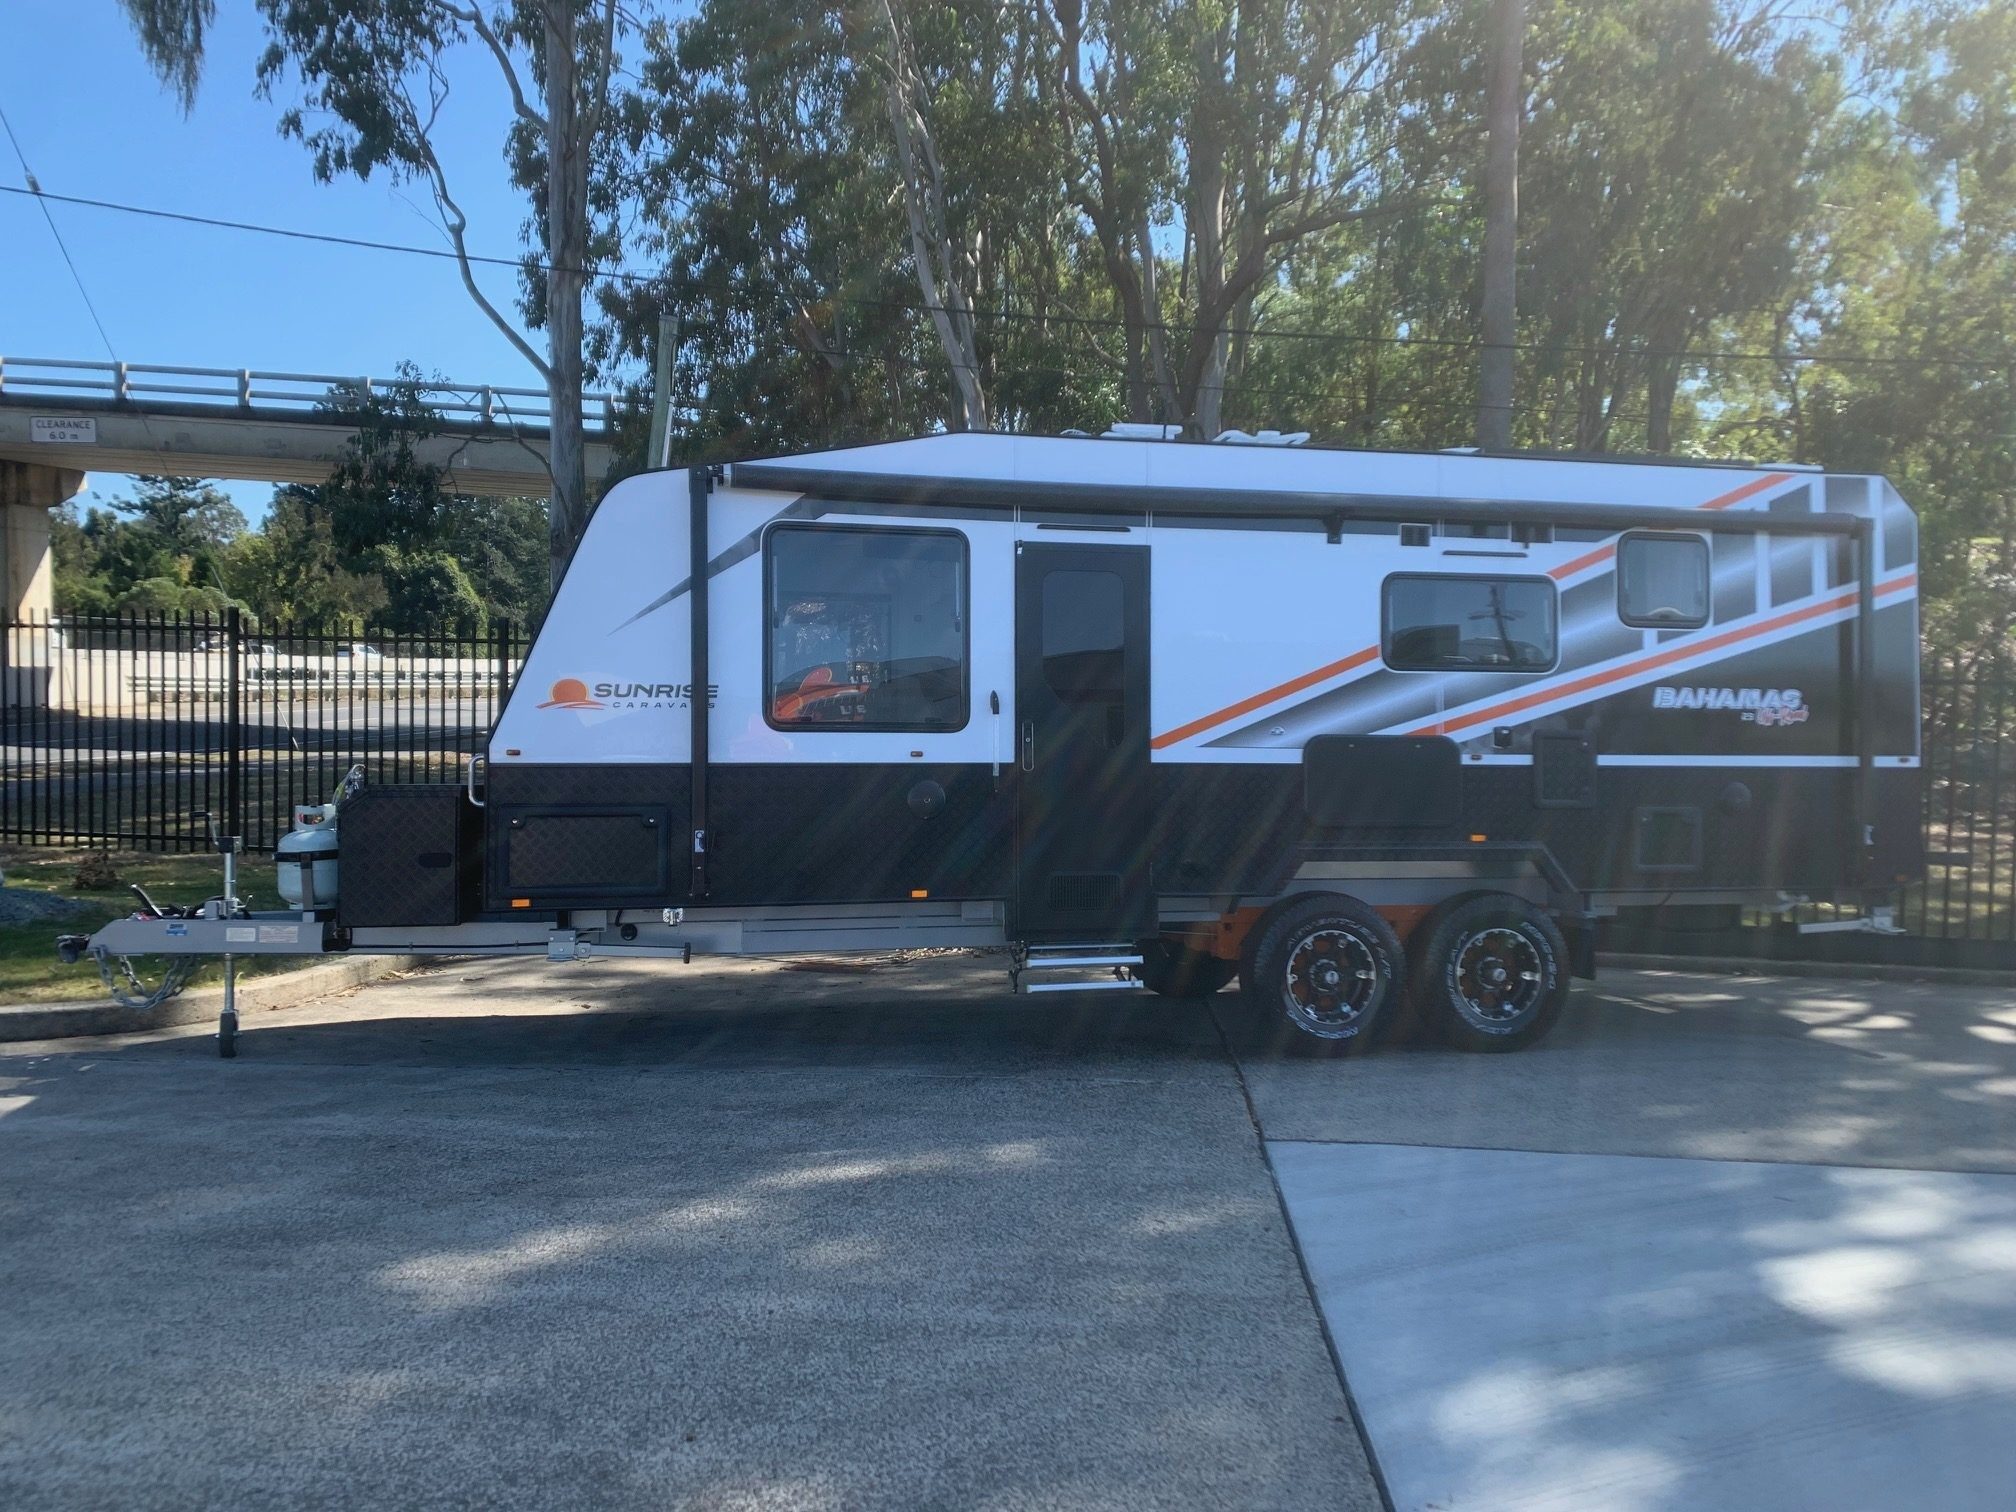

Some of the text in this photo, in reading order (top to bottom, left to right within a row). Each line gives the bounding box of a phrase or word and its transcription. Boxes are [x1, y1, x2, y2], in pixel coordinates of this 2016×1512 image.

[35, 419, 91, 430] CLEARANCE
[1653, 686, 1802, 709] BAHAMAS
[612, 701, 716, 709] CARAVAS
